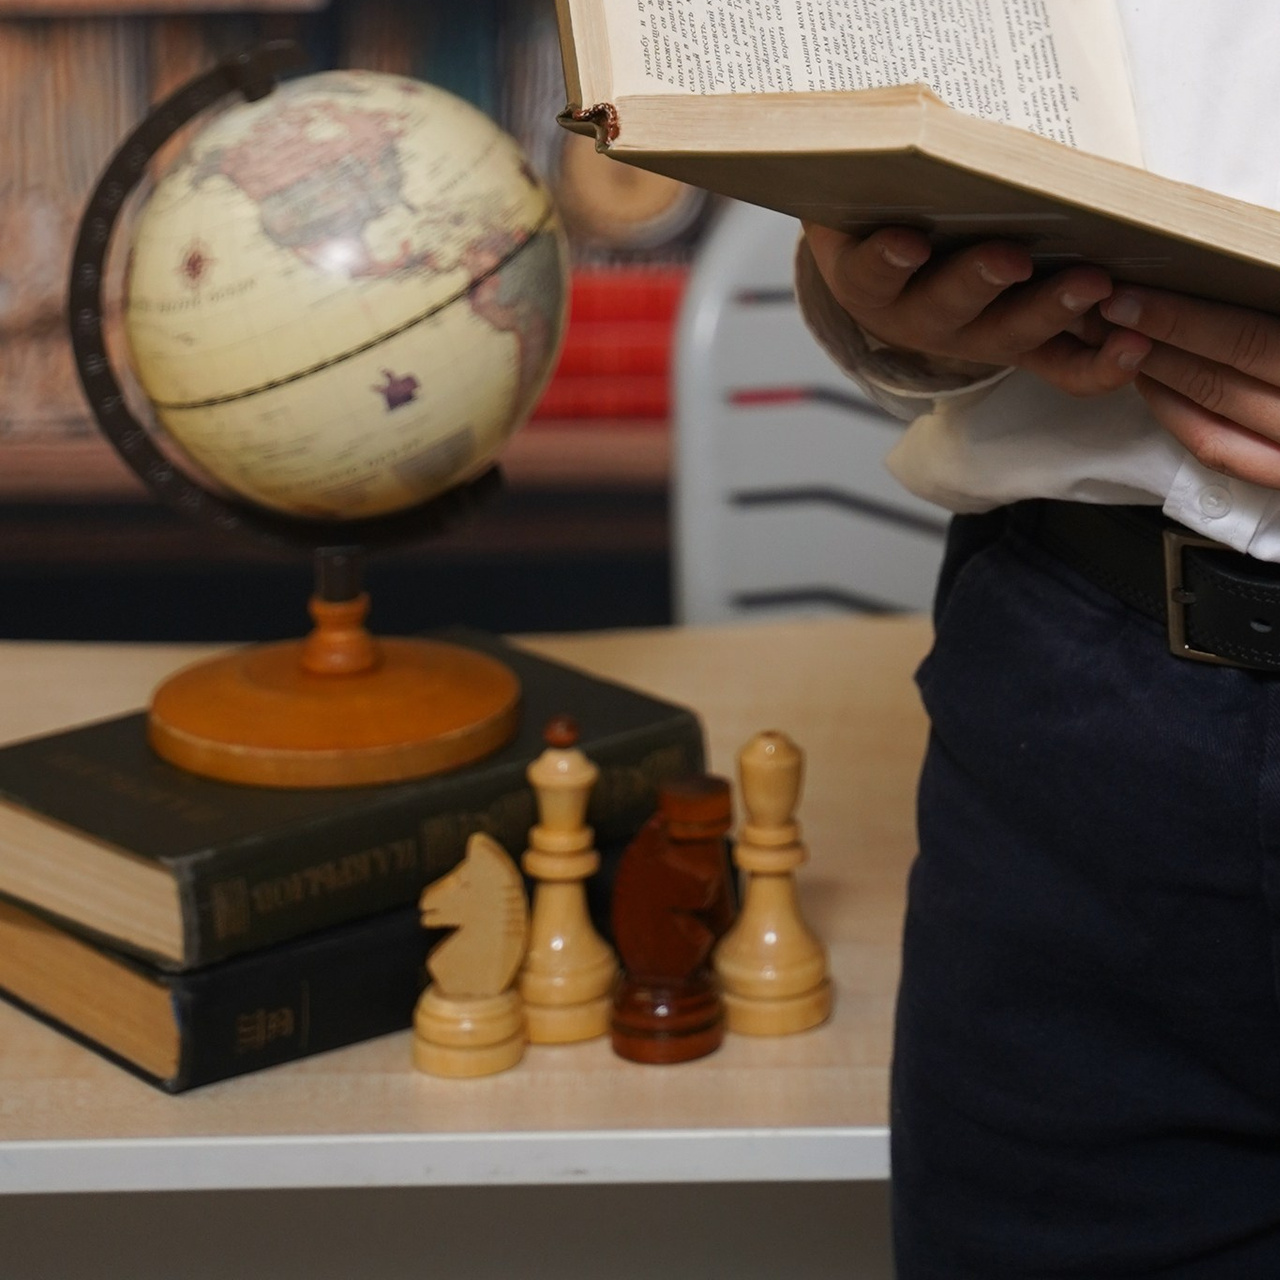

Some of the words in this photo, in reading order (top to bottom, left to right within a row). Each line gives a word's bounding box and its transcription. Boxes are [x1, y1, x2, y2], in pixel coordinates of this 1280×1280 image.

[666, 0, 678, 33] пошли
[677, 8, 688, 39] нутре
[687, 11, 699, 46] десять
[639, 34, 654, 78] усадьбу
[649, 13, 665, 81] пристоящего
[662, 34, 673, 70] может,
[699, 21, 710, 56] чесать.
[705, 9, 725, 85] Тарантаевский
[673, 40, 685, 88] ногласно
[691, 51, 706, 96] который
[704, 59, 716, 91] пошел
